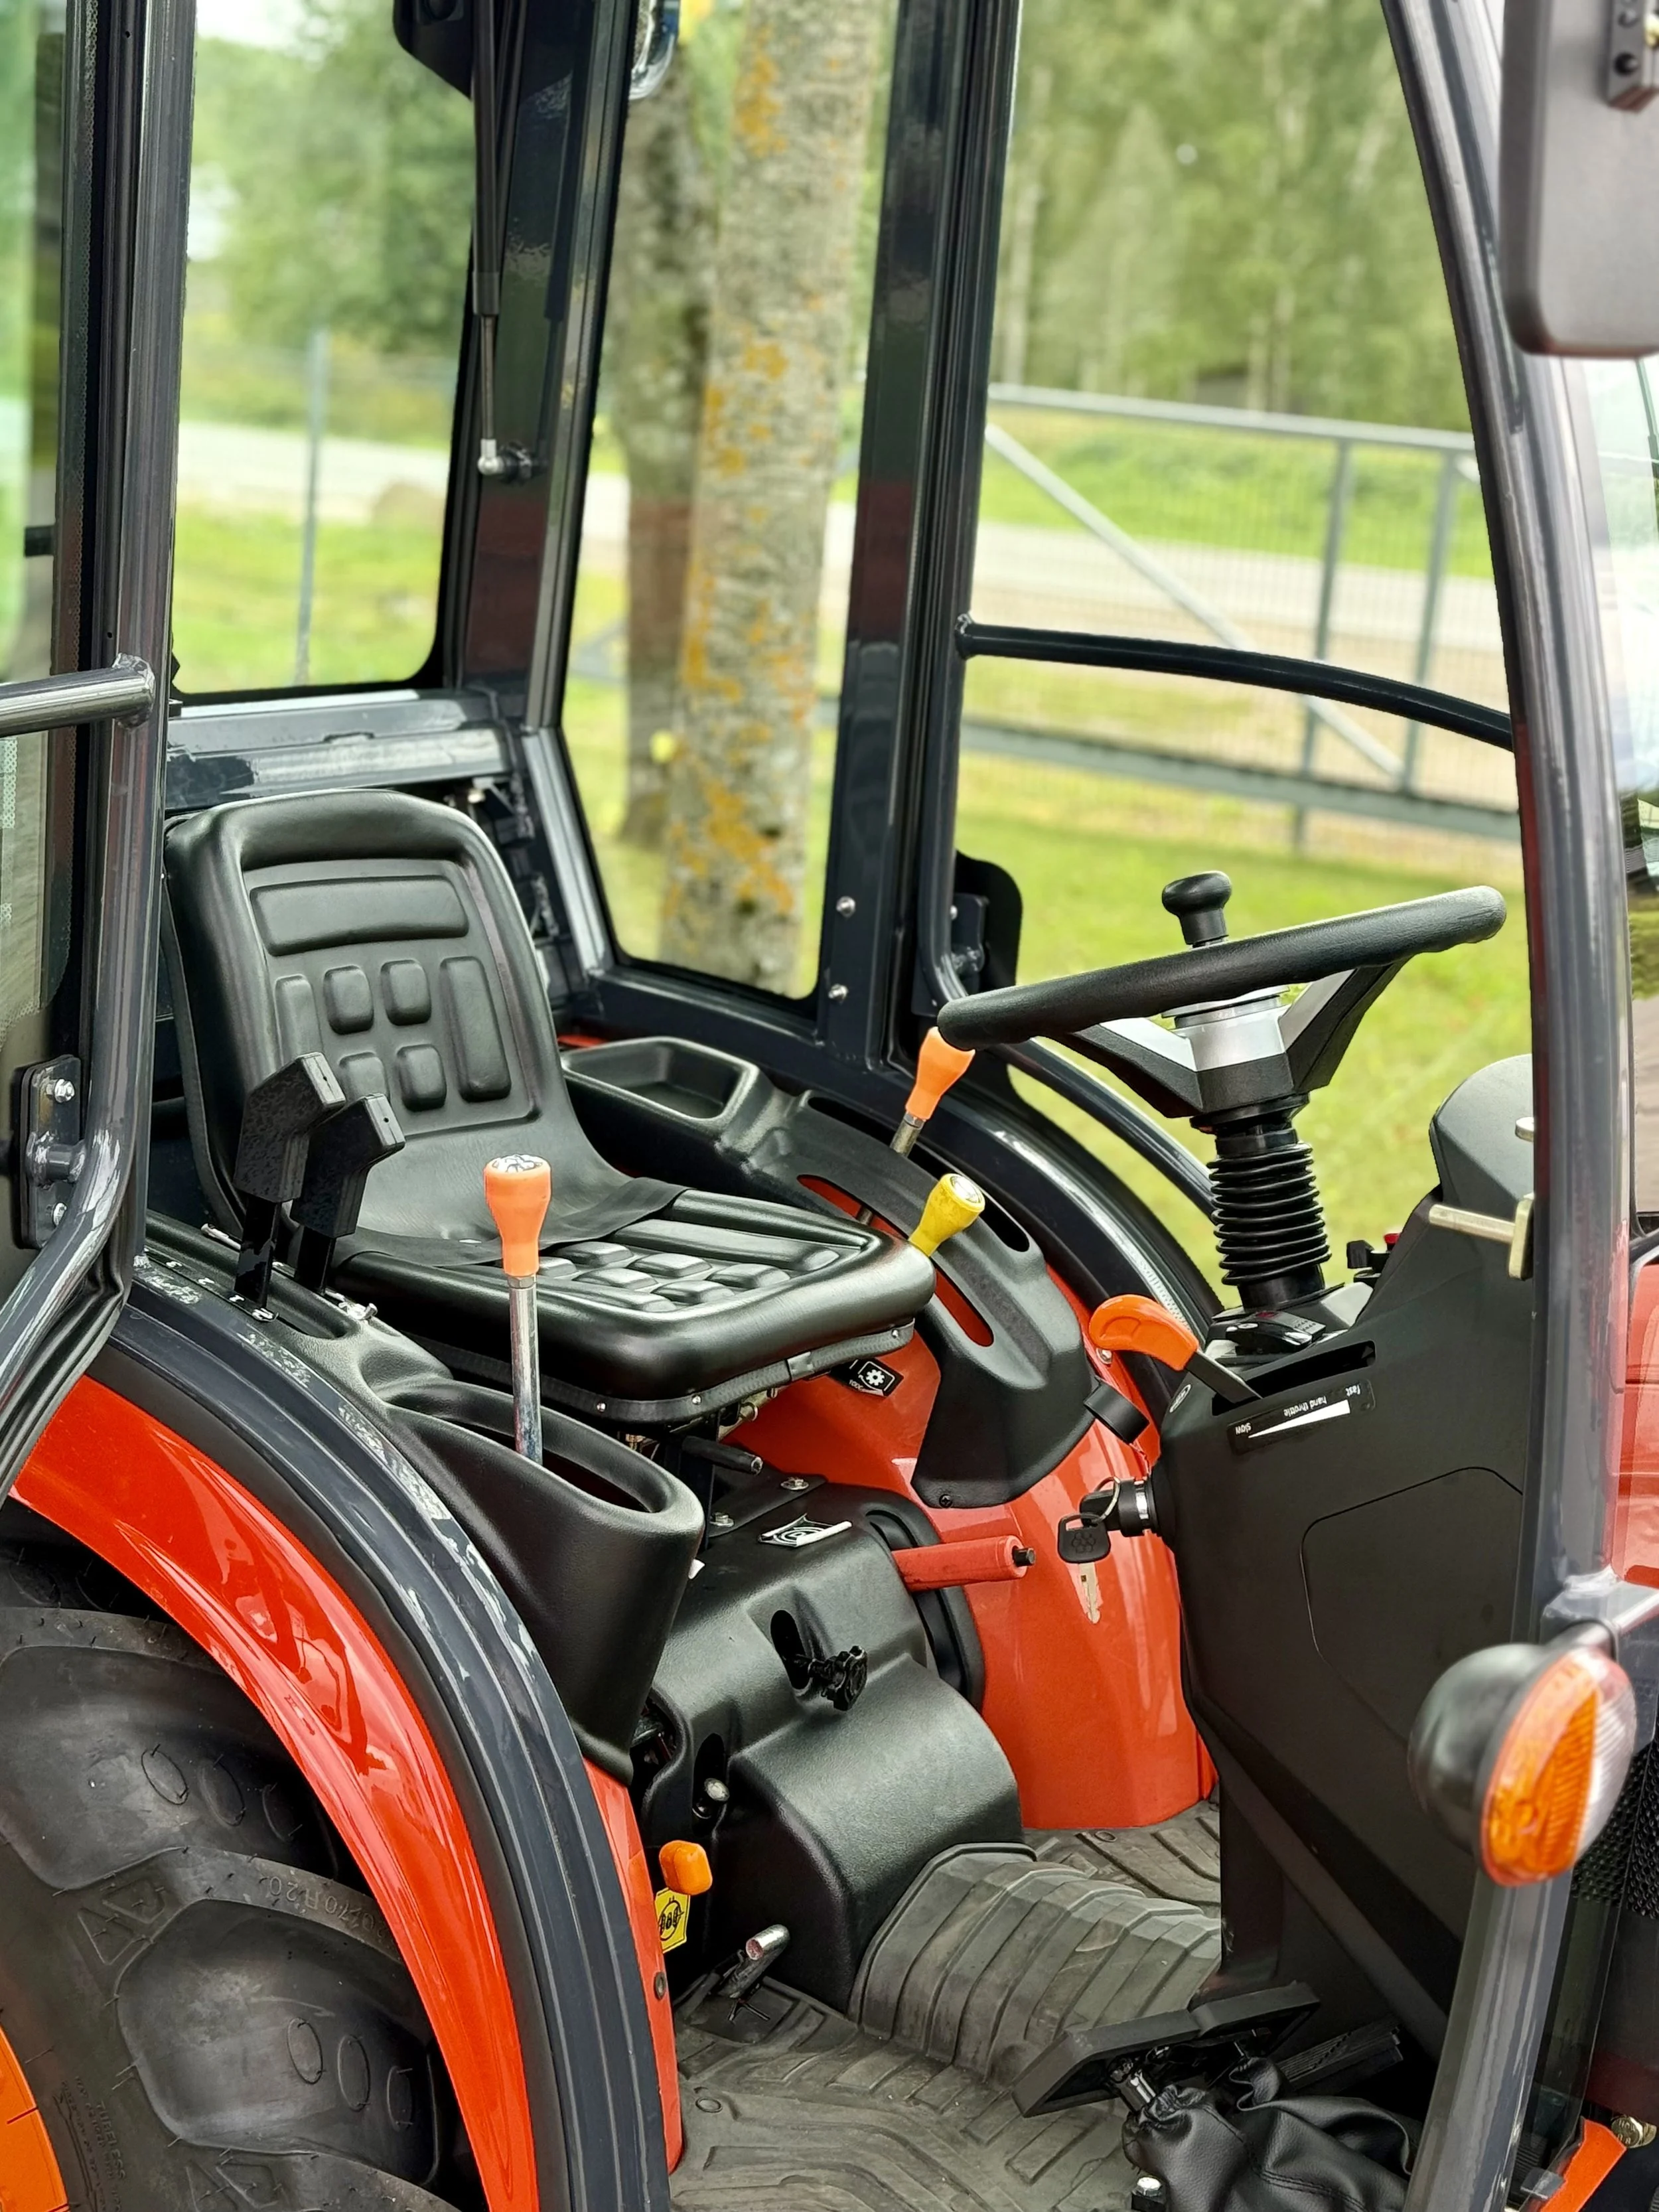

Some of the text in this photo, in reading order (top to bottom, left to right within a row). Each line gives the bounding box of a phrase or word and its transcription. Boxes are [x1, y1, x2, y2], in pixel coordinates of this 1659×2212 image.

[1345, 1384, 1361, 1396] fast
[1283, 1396, 1328, 1417] hand throttle
[1235, 1422, 1252, 1435] slow
